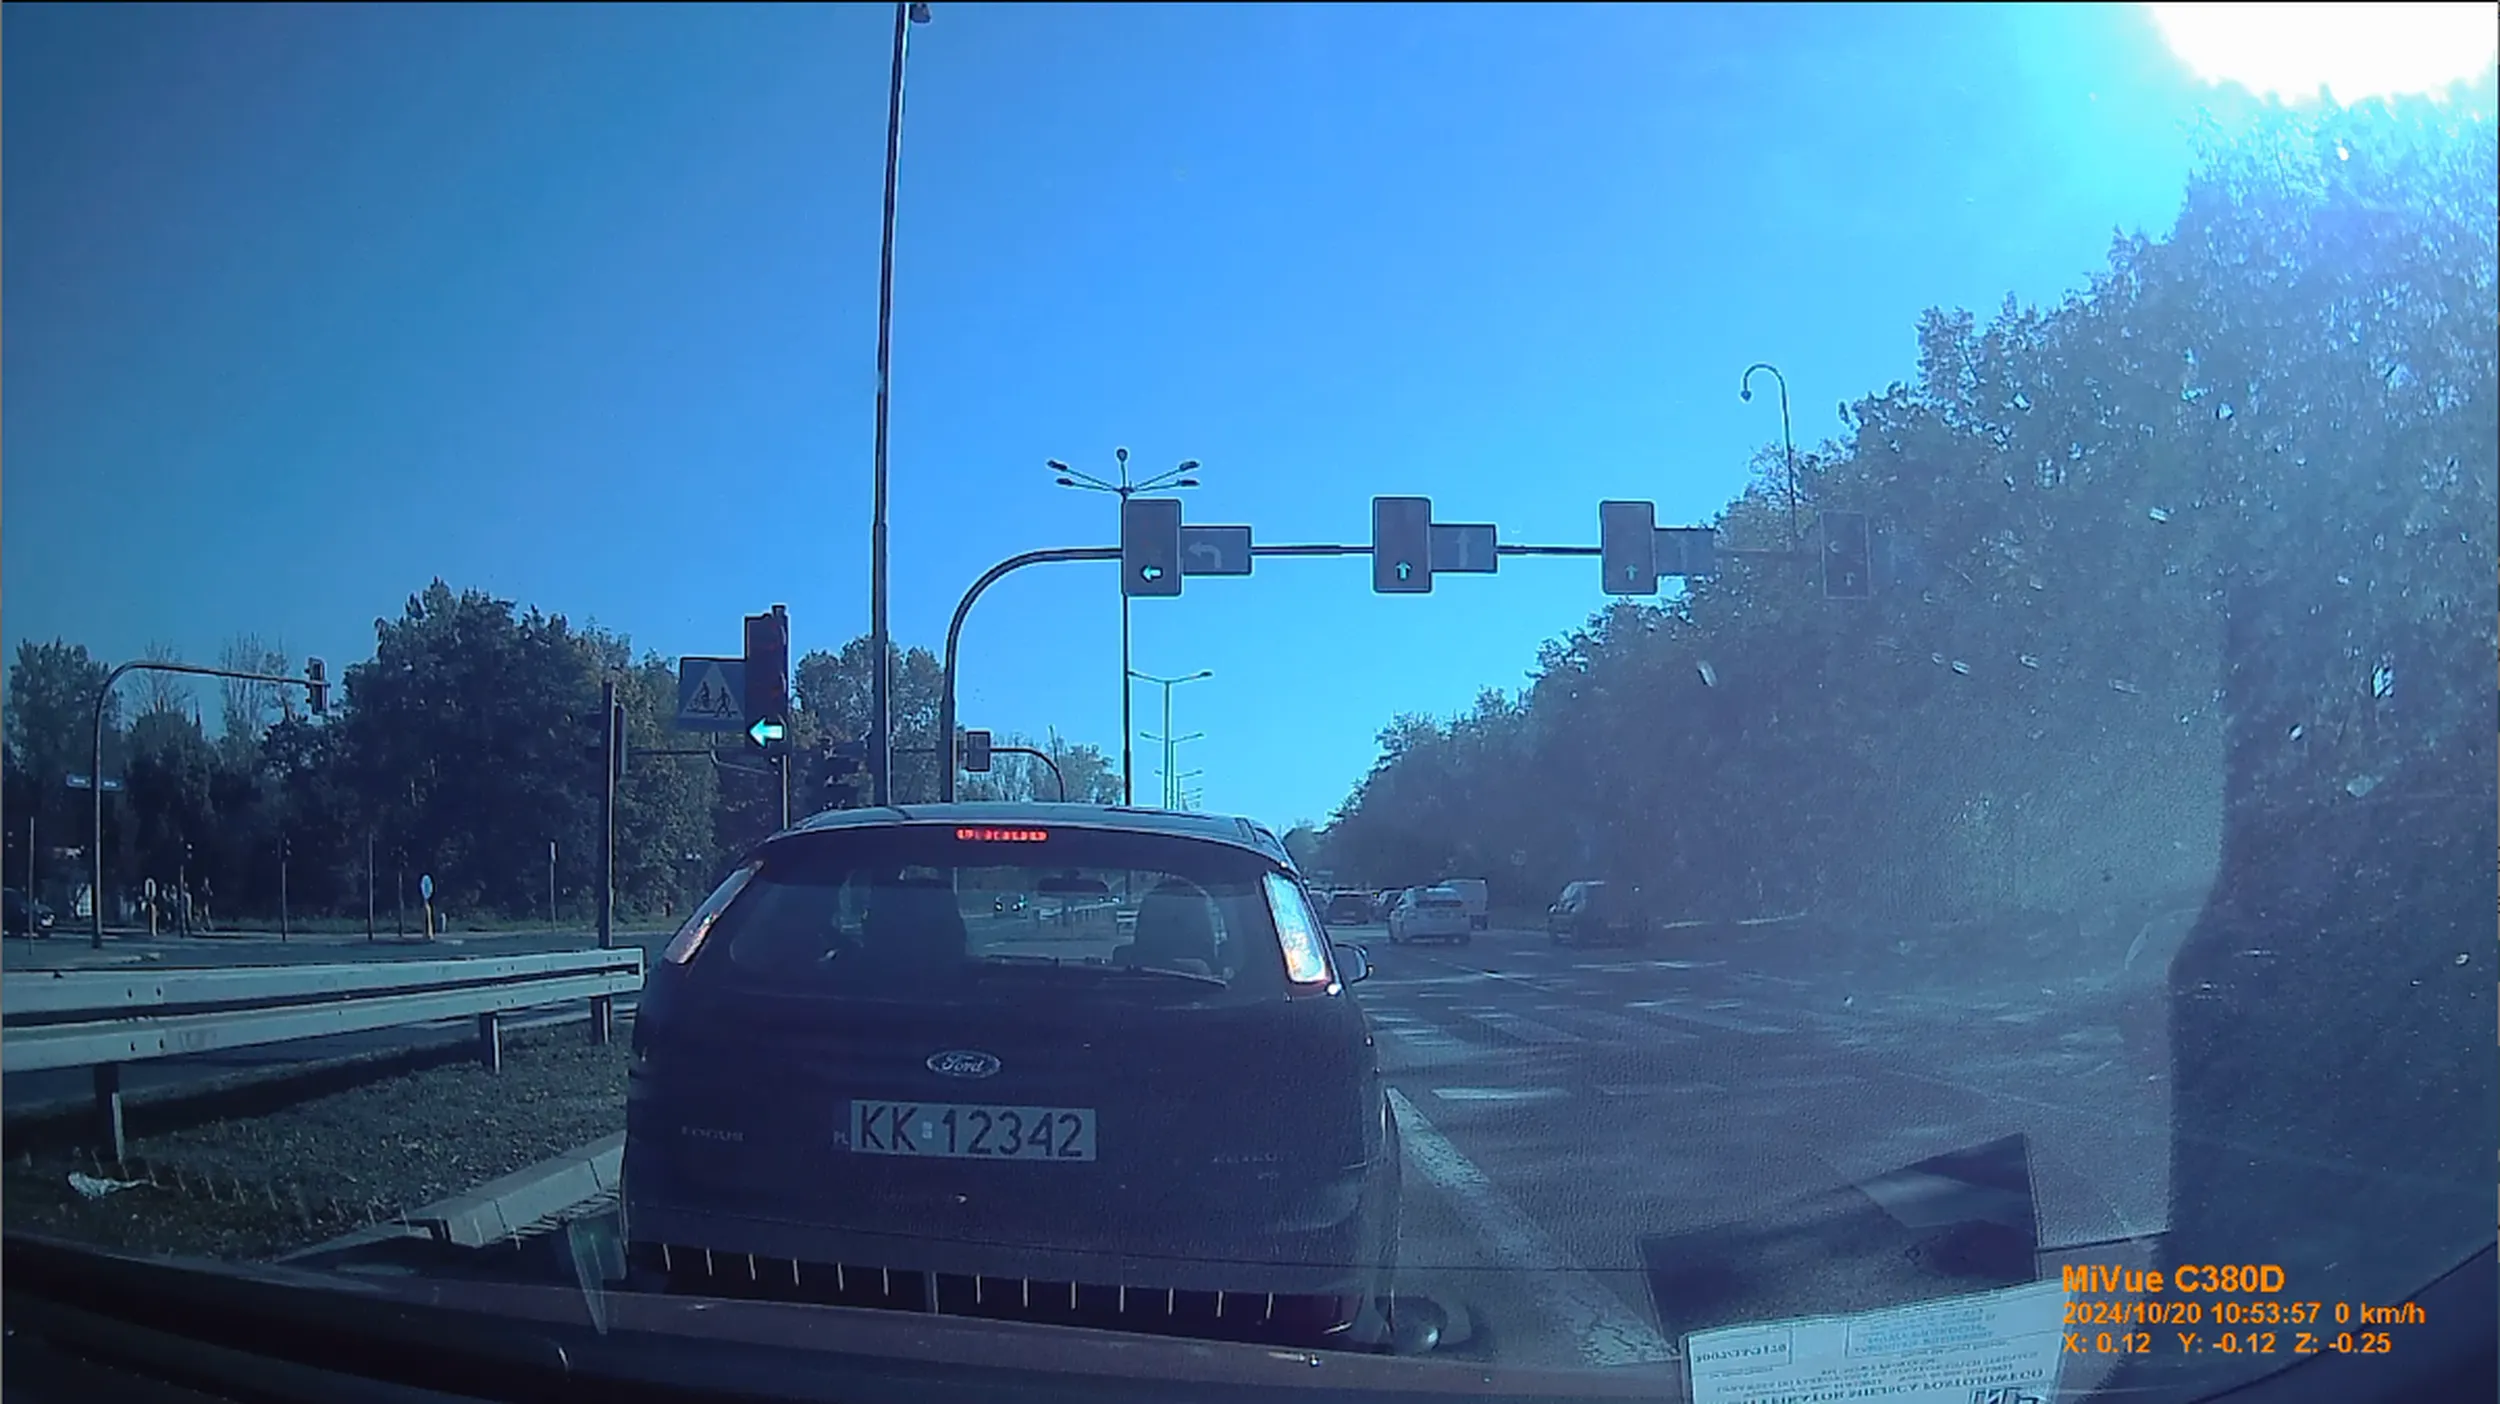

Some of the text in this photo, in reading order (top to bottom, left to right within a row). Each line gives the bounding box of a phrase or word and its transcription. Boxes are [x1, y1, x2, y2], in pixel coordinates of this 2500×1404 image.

[942, 1055, 985, 1073] Ford
[861, 1105, 1083, 1157] KK 12342
